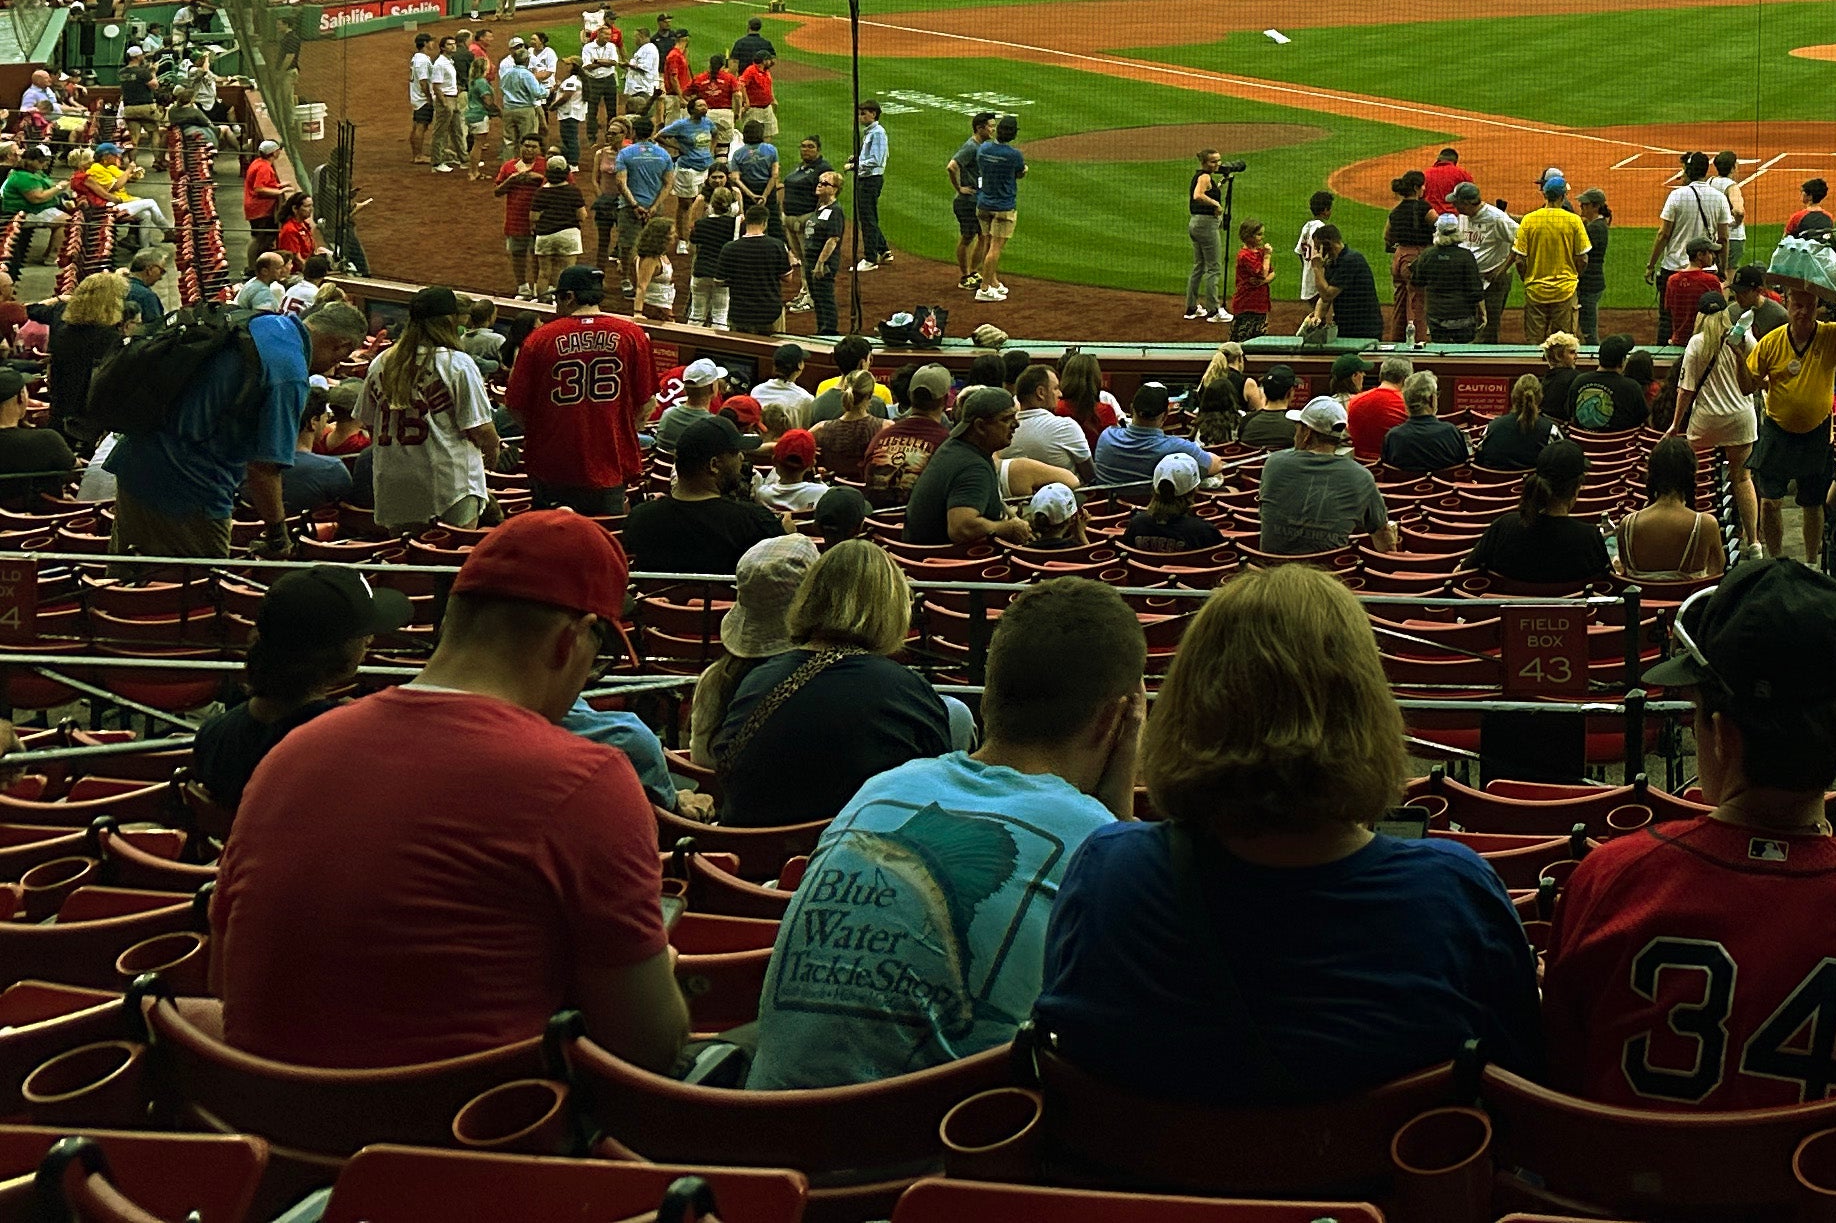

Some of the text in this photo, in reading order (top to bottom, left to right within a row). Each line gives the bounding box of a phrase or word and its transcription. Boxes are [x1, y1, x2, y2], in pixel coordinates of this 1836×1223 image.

[320, 8, 374, 32] Safelite
[556, 331, 621, 356] CASAS
[551, 356, 624, 406] 36
[1457, 383, 1507, 393] CAUTION!
[1518, 618, 1571, 631] FIELD
[1527, 634, 1564, 649] BOX
[1518, 656, 1572, 683] 43
[808, 867, 897, 908] Blue
[803, 908, 909, 955] Water
[788, 950, 872, 993] Tackle
